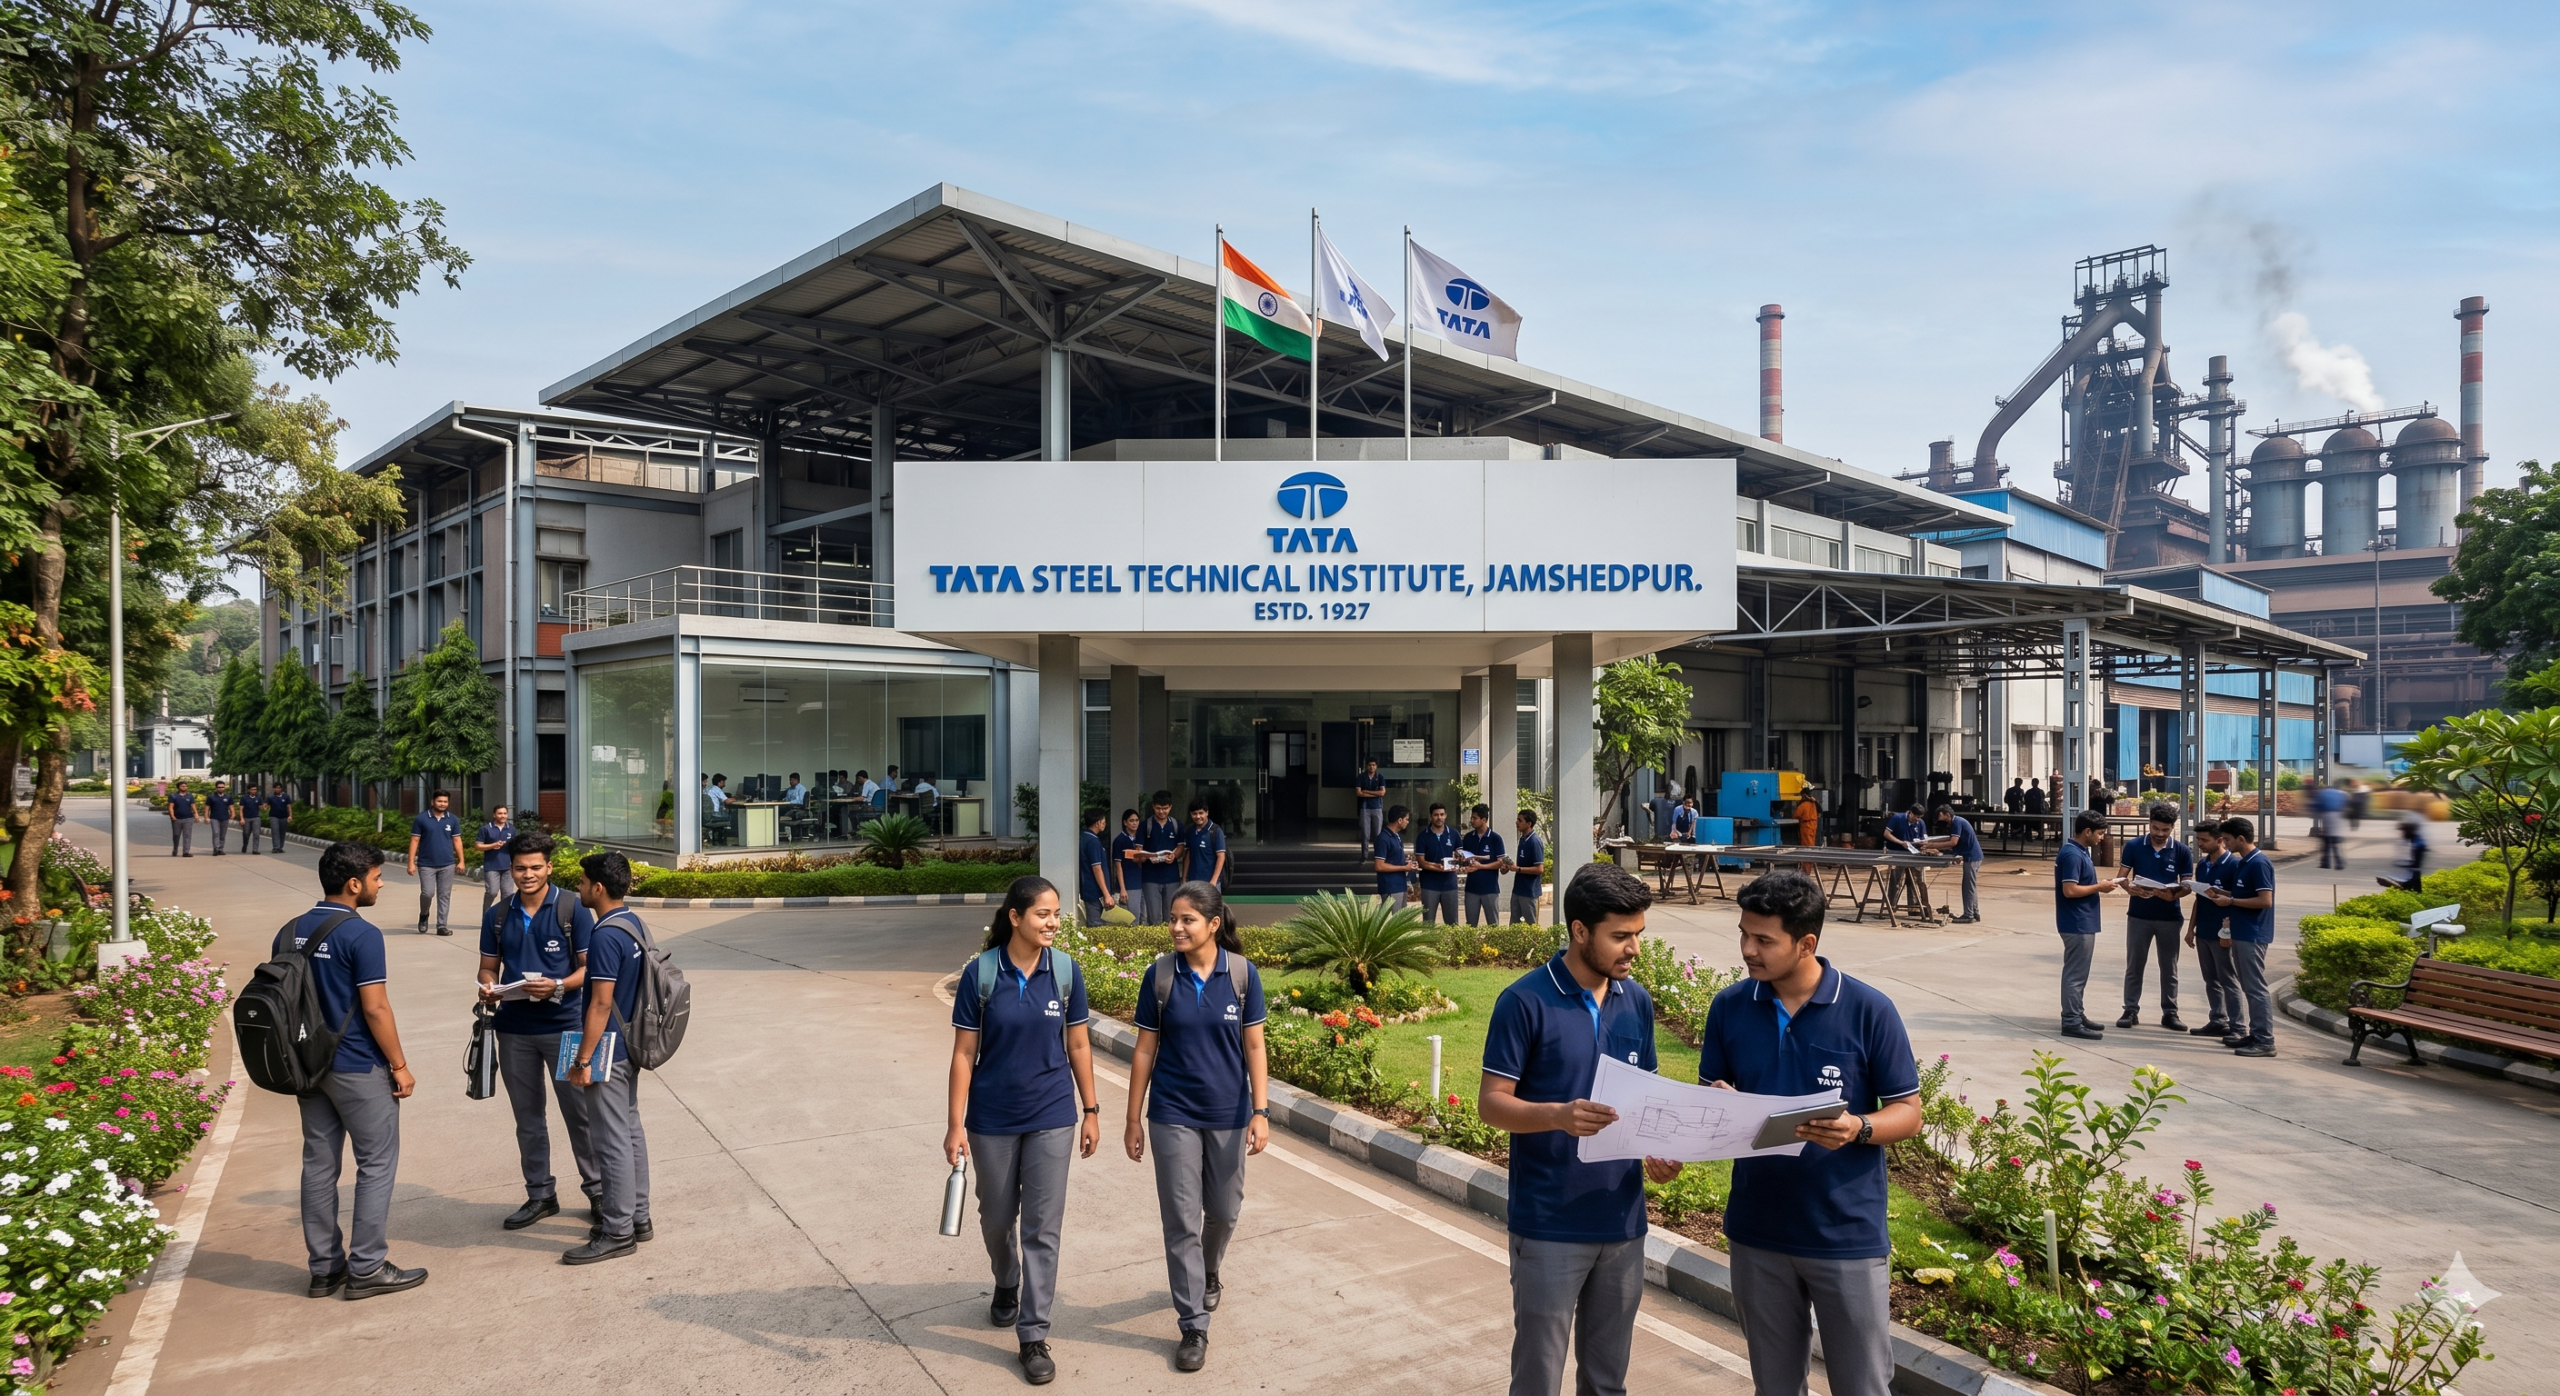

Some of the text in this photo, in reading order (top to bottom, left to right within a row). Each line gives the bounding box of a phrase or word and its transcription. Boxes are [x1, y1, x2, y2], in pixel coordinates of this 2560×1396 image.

[1436, 307, 1490, 340] TATA
[1267, 527, 1358, 553] TATA
[929, 563, 1703, 596] TATA STEEL TECHNICAL INSTITUTE, JAMSHEDPUR.
[1255, 602, 1370, 621] ESTD. 1927
